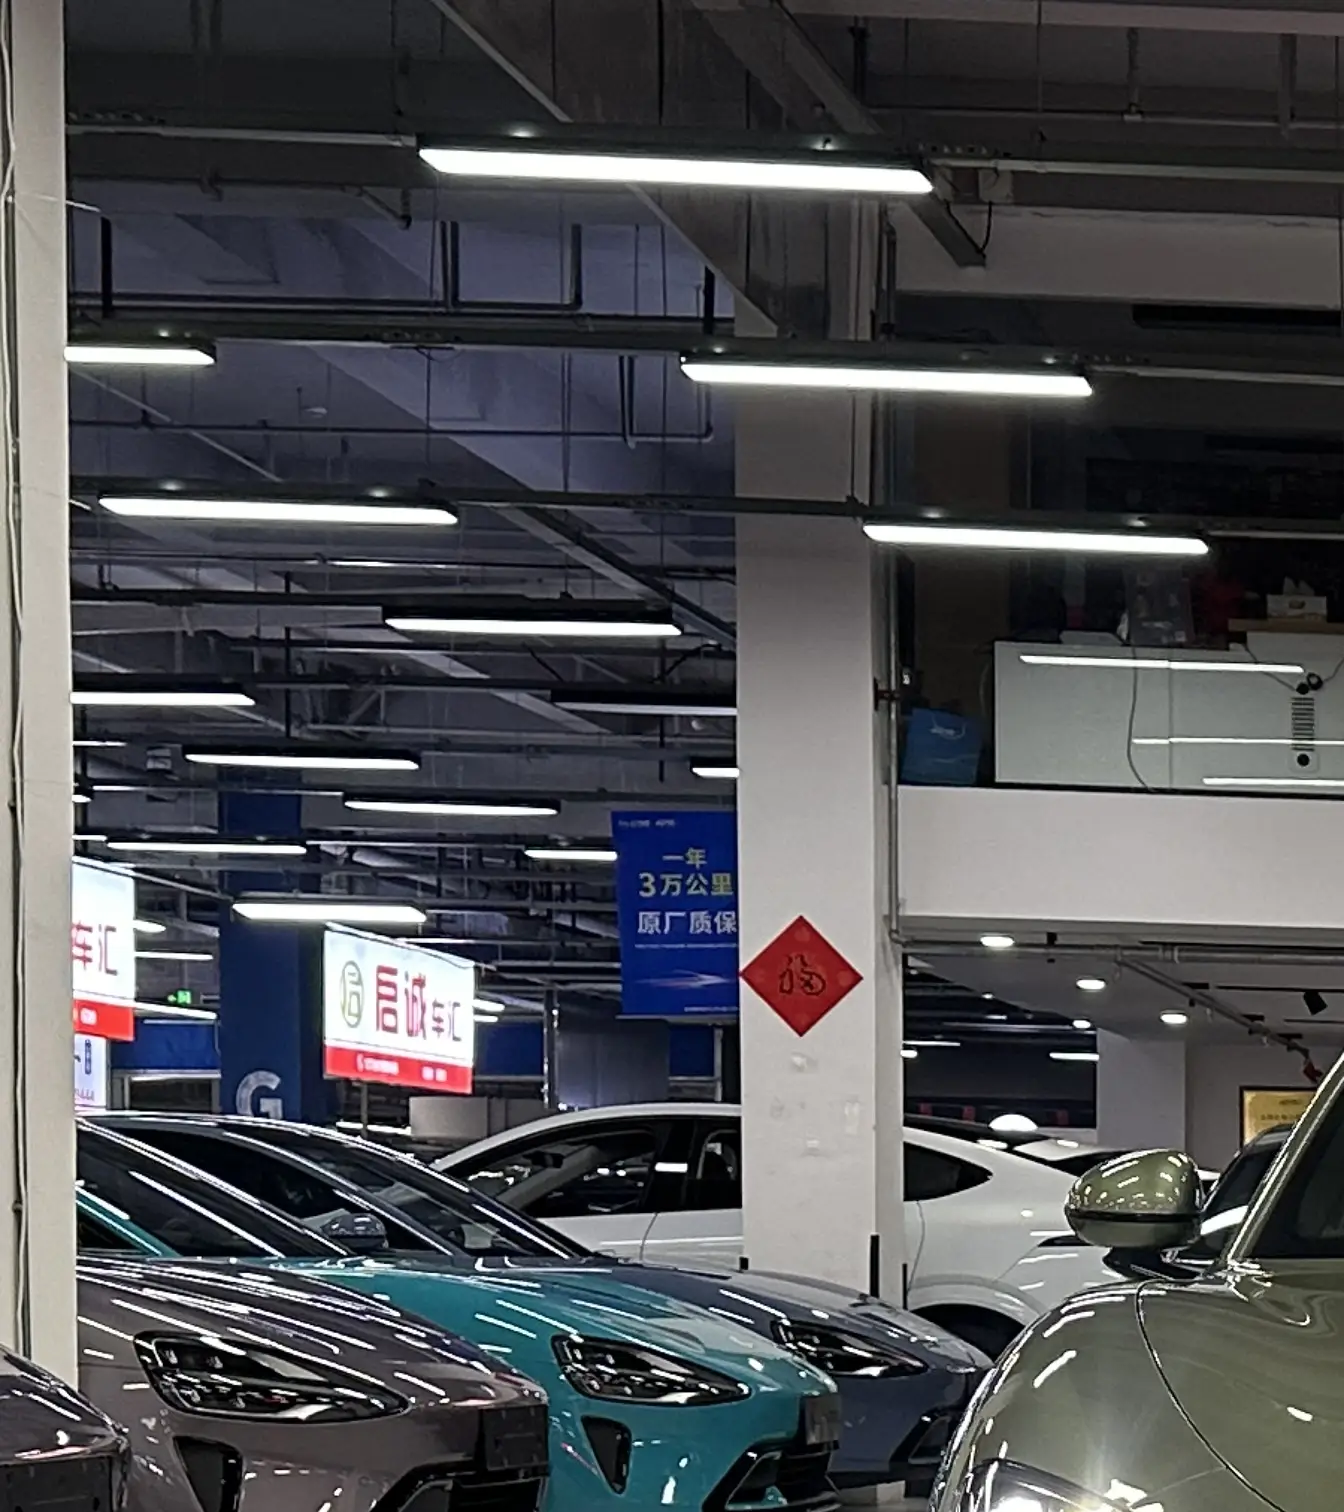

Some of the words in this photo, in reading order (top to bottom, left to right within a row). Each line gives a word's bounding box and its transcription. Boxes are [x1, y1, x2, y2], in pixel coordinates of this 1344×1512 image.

[662, 847, 707, 869] 一年
[638, 872, 734, 897] 3万公里
[637, 911, 738, 934] 原厂质保
[236, 1070, 284, 1120] G
